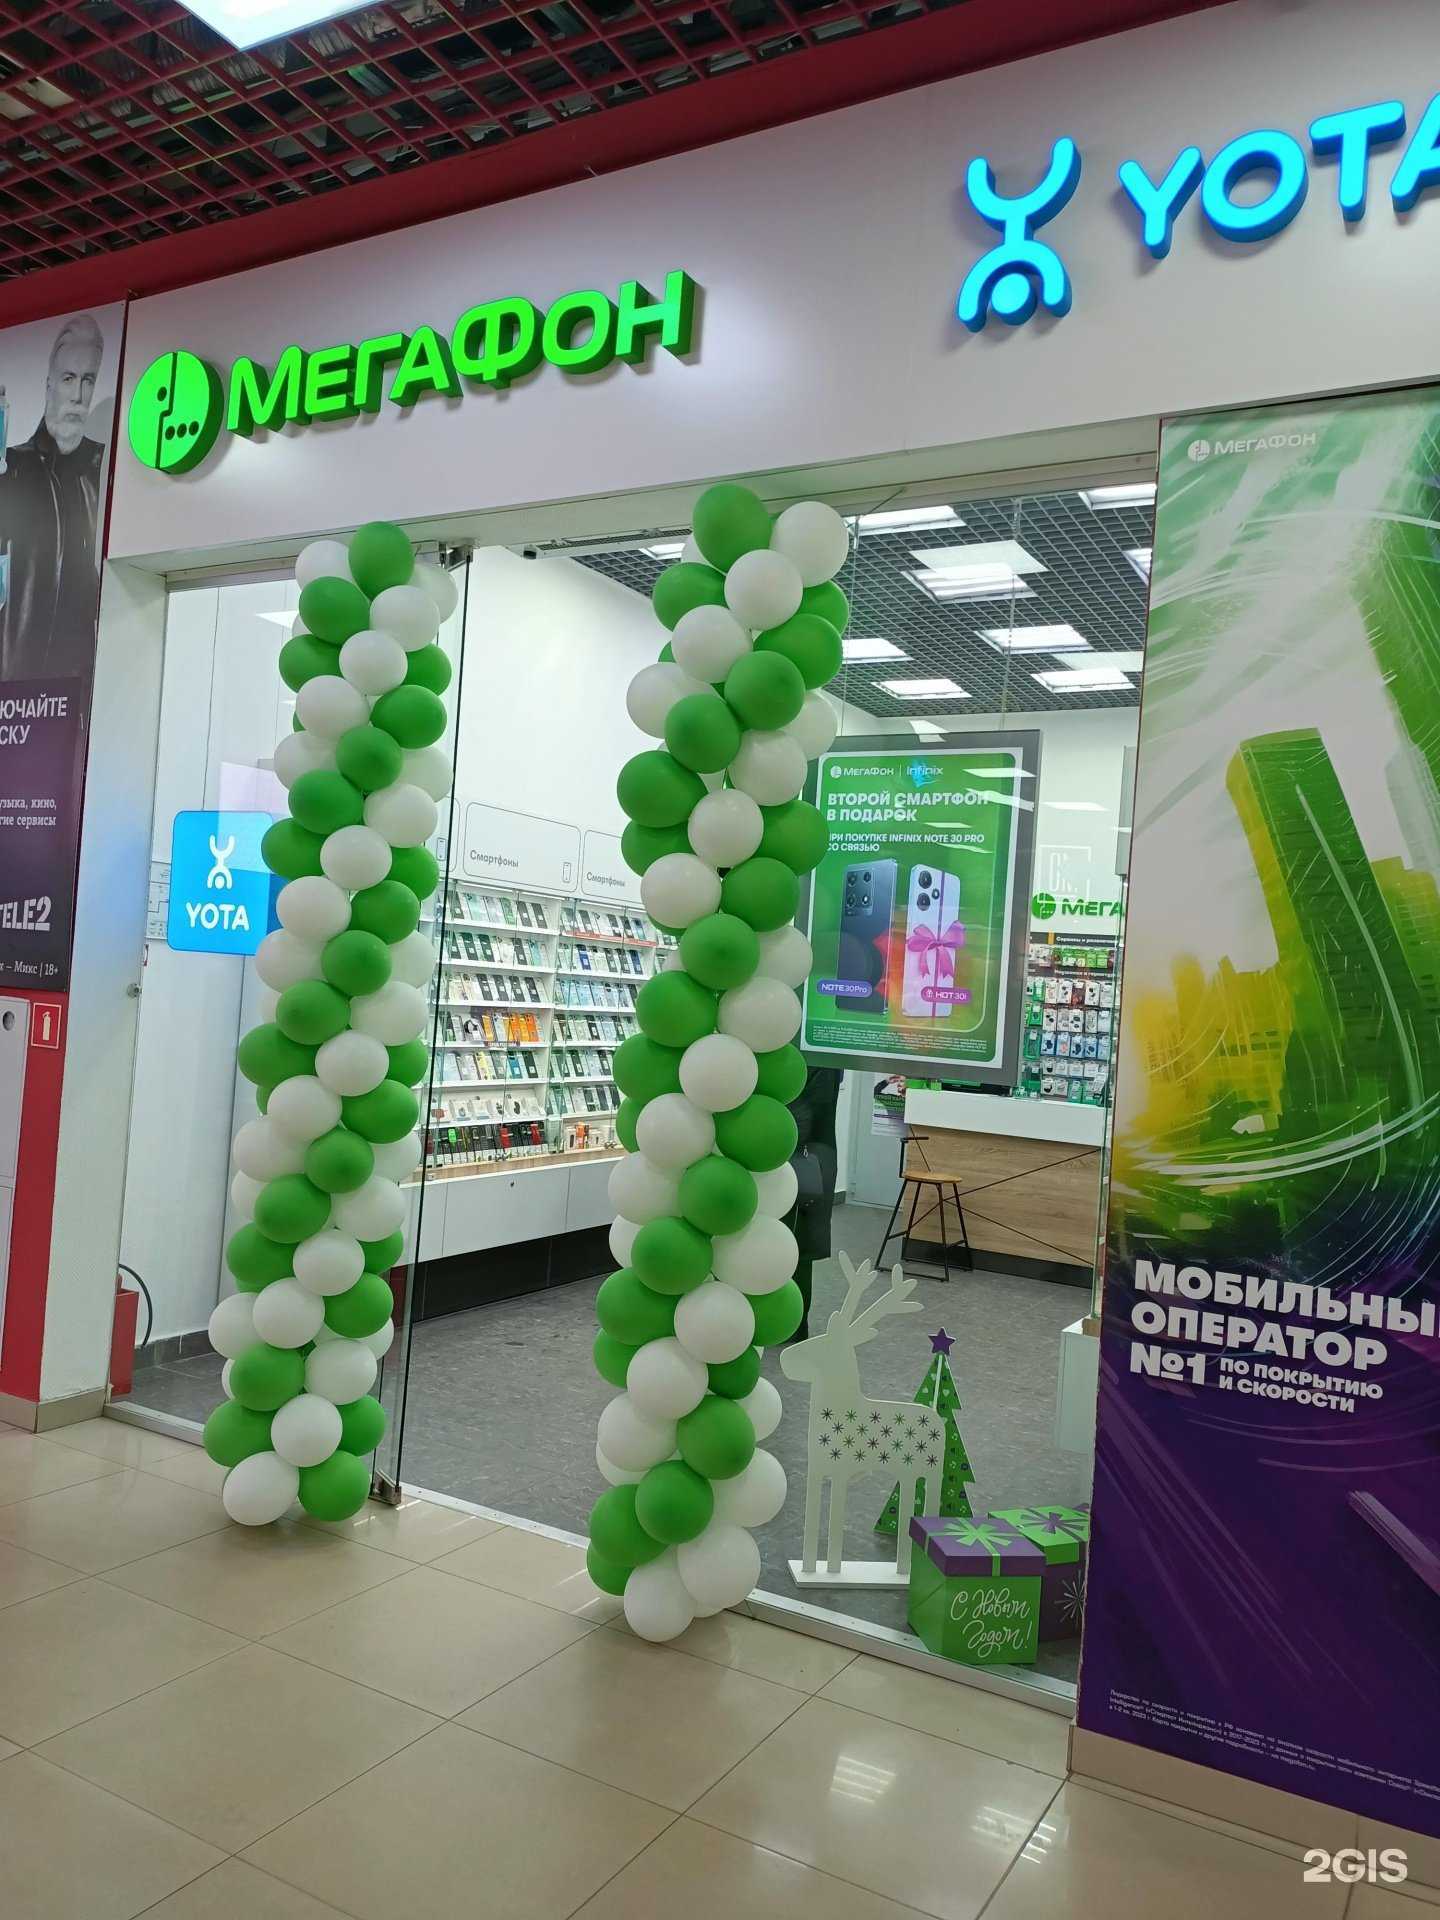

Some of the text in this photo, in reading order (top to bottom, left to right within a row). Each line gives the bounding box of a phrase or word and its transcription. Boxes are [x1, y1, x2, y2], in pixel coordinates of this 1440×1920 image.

[227, 270, 695, 437] МЕГАФОН
[1214, 433, 1316, 455] МЕГАФОН
[0, 693, 68, 719] ЮЧАЙТЕ
[0, 725, 31, 745] СКУ
[31, 799, 57, 811] кино,
[828, 790, 891, 806] ВТОРОЙ
[17, 816, 57, 830] сервисы
[827, 808, 917, 823] В ПОДАРОК
[841, 842, 880, 852] СВЯЗЬЮ
[845, 832, 887, 842] ПОКУПКЕ
[889, 833, 921, 843] INFINIX
[924, 833, 948, 843] NOTE
[950, 834, 962, 843] 30
[964, 834, 985, 843] PRO
[470, 850, 519, 868] Смартфоны
[586, 872, 626, 887] Смартфоны
[185, 902, 250, 931] YOTA
[14, 961, 38, 975] Микс
[45, 963, 59, 976] 18+
[1134, 1259, 1440, 1338] МОБИЛЬНЫ
[1131, 1301, 1388, 1371] ОПЕРАТОР
[1130, 1342, 1384, 1400] №1 ПО ПОКРЫТИЮ
[1219, 1375, 1355, 1414] И СКОРОСТИ
[972, 1588, 1031, 1619] Новым
